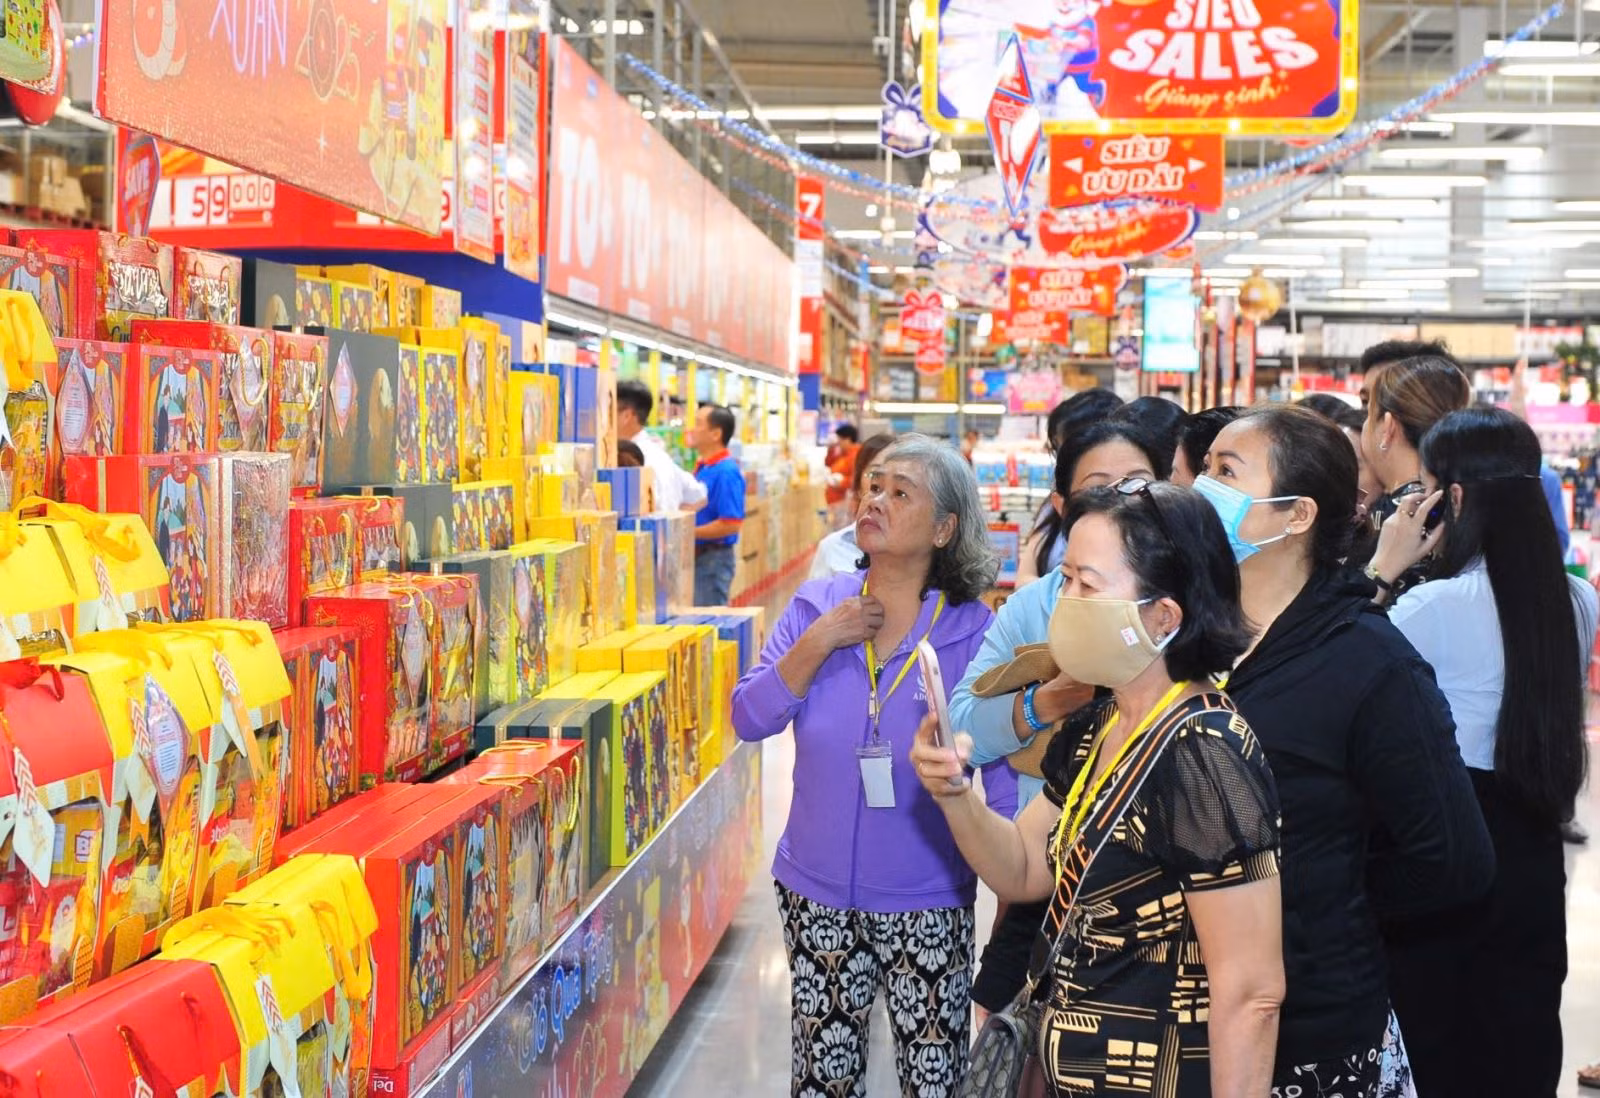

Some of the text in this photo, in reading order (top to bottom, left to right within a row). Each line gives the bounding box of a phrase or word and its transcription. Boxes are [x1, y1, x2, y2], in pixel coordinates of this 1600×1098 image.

[1109, 27, 1319, 80] SALES
[800, 193, 821, 219] 7
[1048, 832, 1094, 933] LOVE
